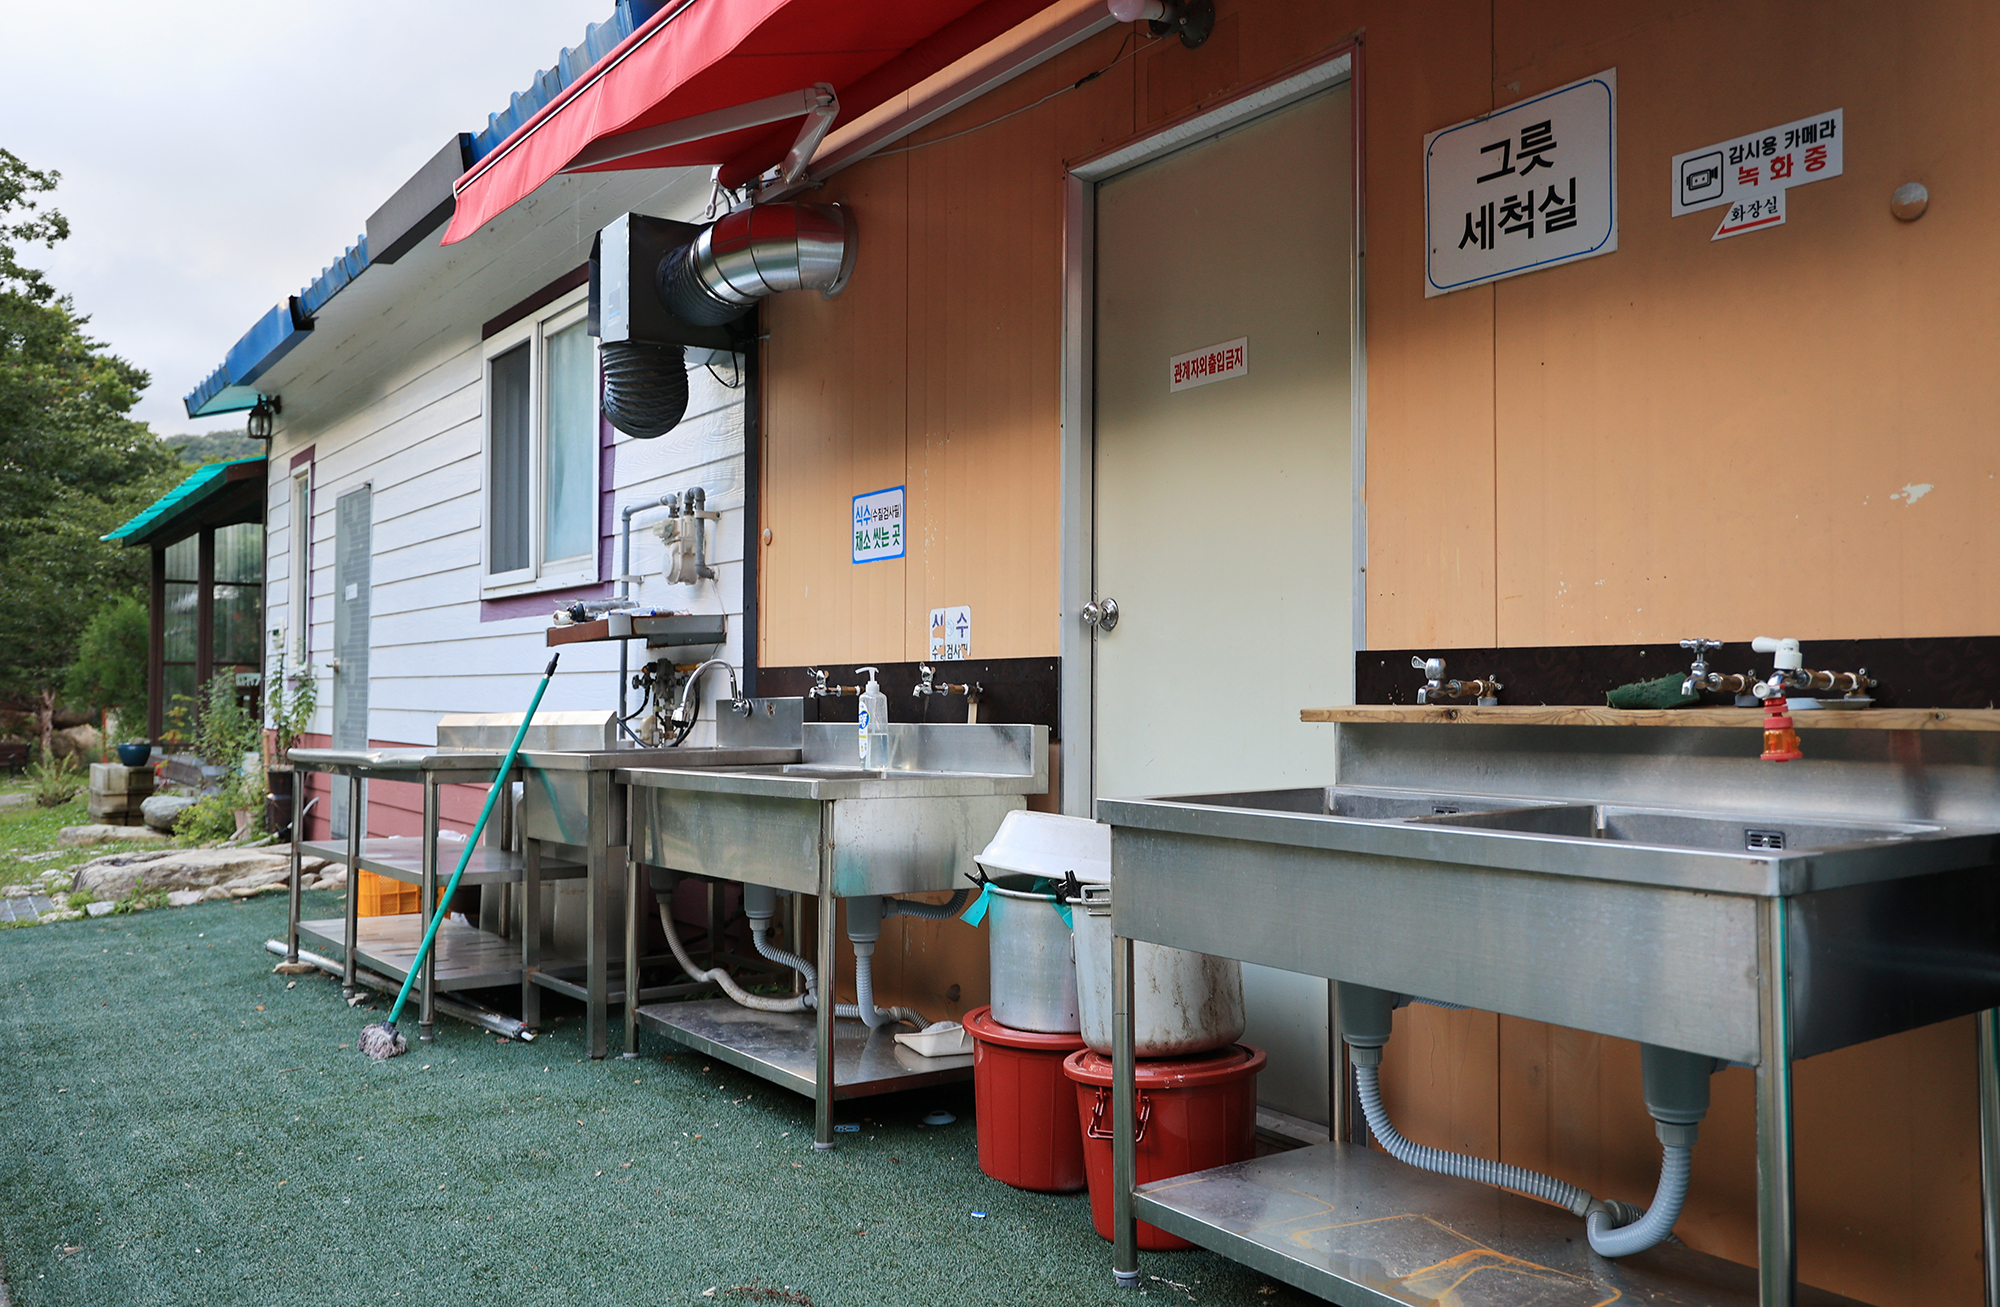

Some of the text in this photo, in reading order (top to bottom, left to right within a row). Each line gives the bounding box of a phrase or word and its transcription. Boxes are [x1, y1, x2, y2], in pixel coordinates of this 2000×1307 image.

[1476, 120, 1557, 184] 그릇
[1729, 119, 1836, 165] 감시용 카메라
[1458, 177, 1578, 250] 세척실
[1731, 196, 1778, 222] 화장실
[1174, 346, 1243, 383] 관계자외출입금지
[855, 524, 900, 551] 채소 씻는 곳
